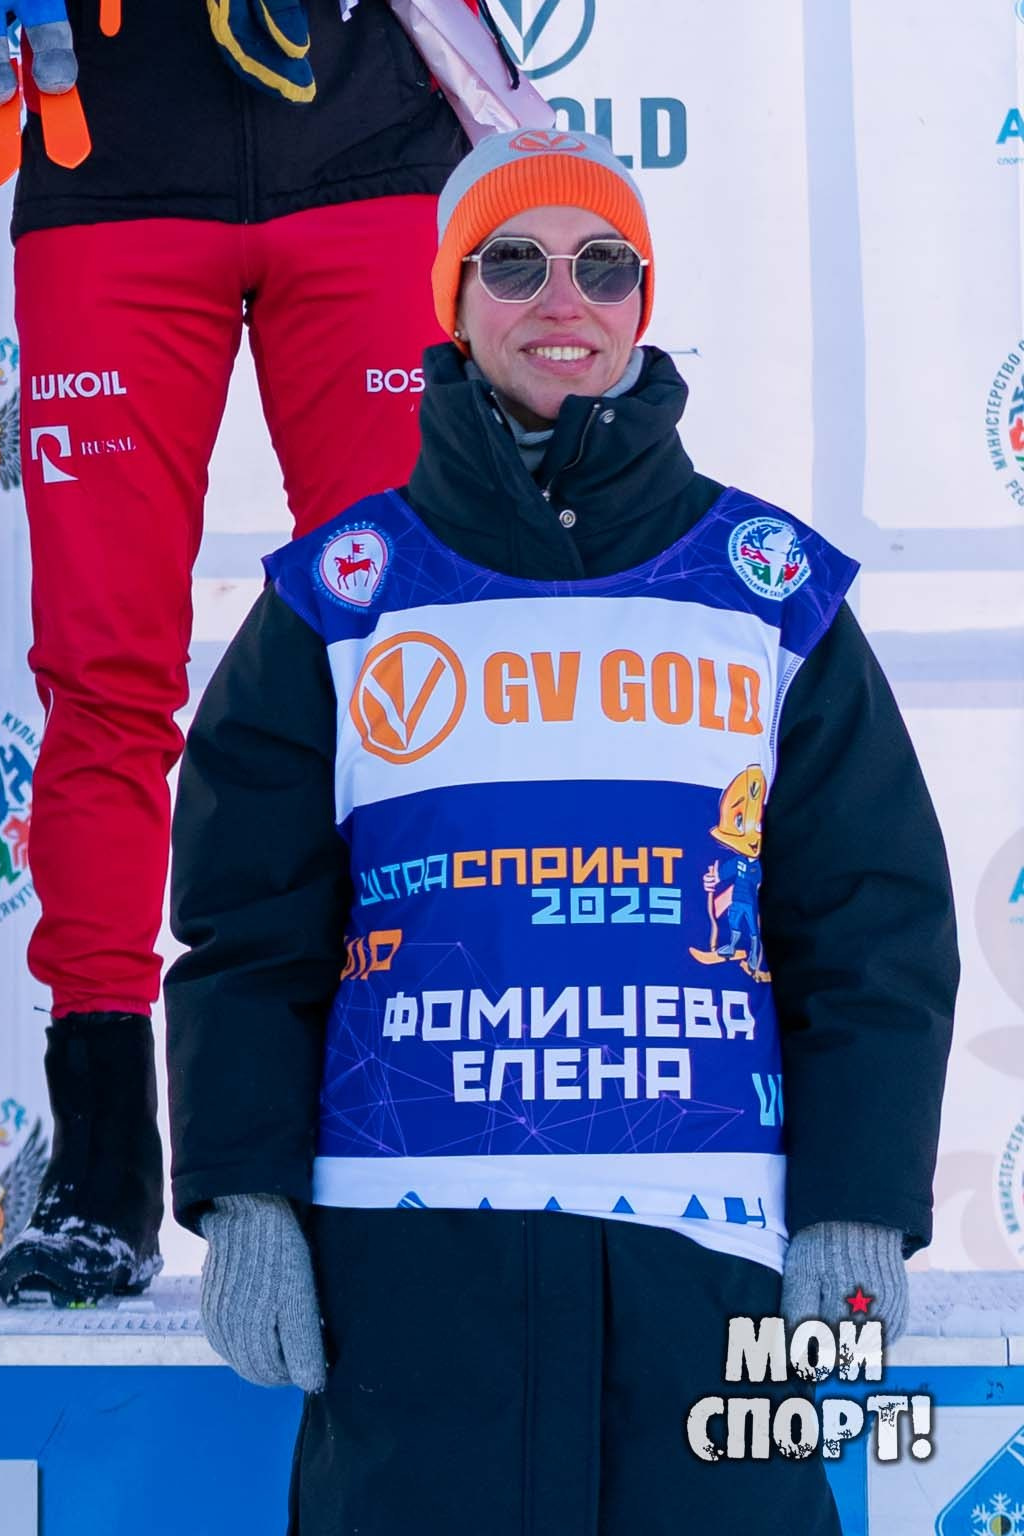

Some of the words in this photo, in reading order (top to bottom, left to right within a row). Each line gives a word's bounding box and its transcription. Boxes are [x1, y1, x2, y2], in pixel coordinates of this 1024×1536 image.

[31, 371, 127, 400] LUKOIL
[81, 437, 136, 456] RUSAL
[483, 651, 581, 724] GV
[600, 649, 763, 735] GOLD
[532, 888, 681, 924] 2025
[382, 985, 755, 1041] ФОМИЧЕВА
[453, 1048, 691, 1102] ЕЛЕНА
